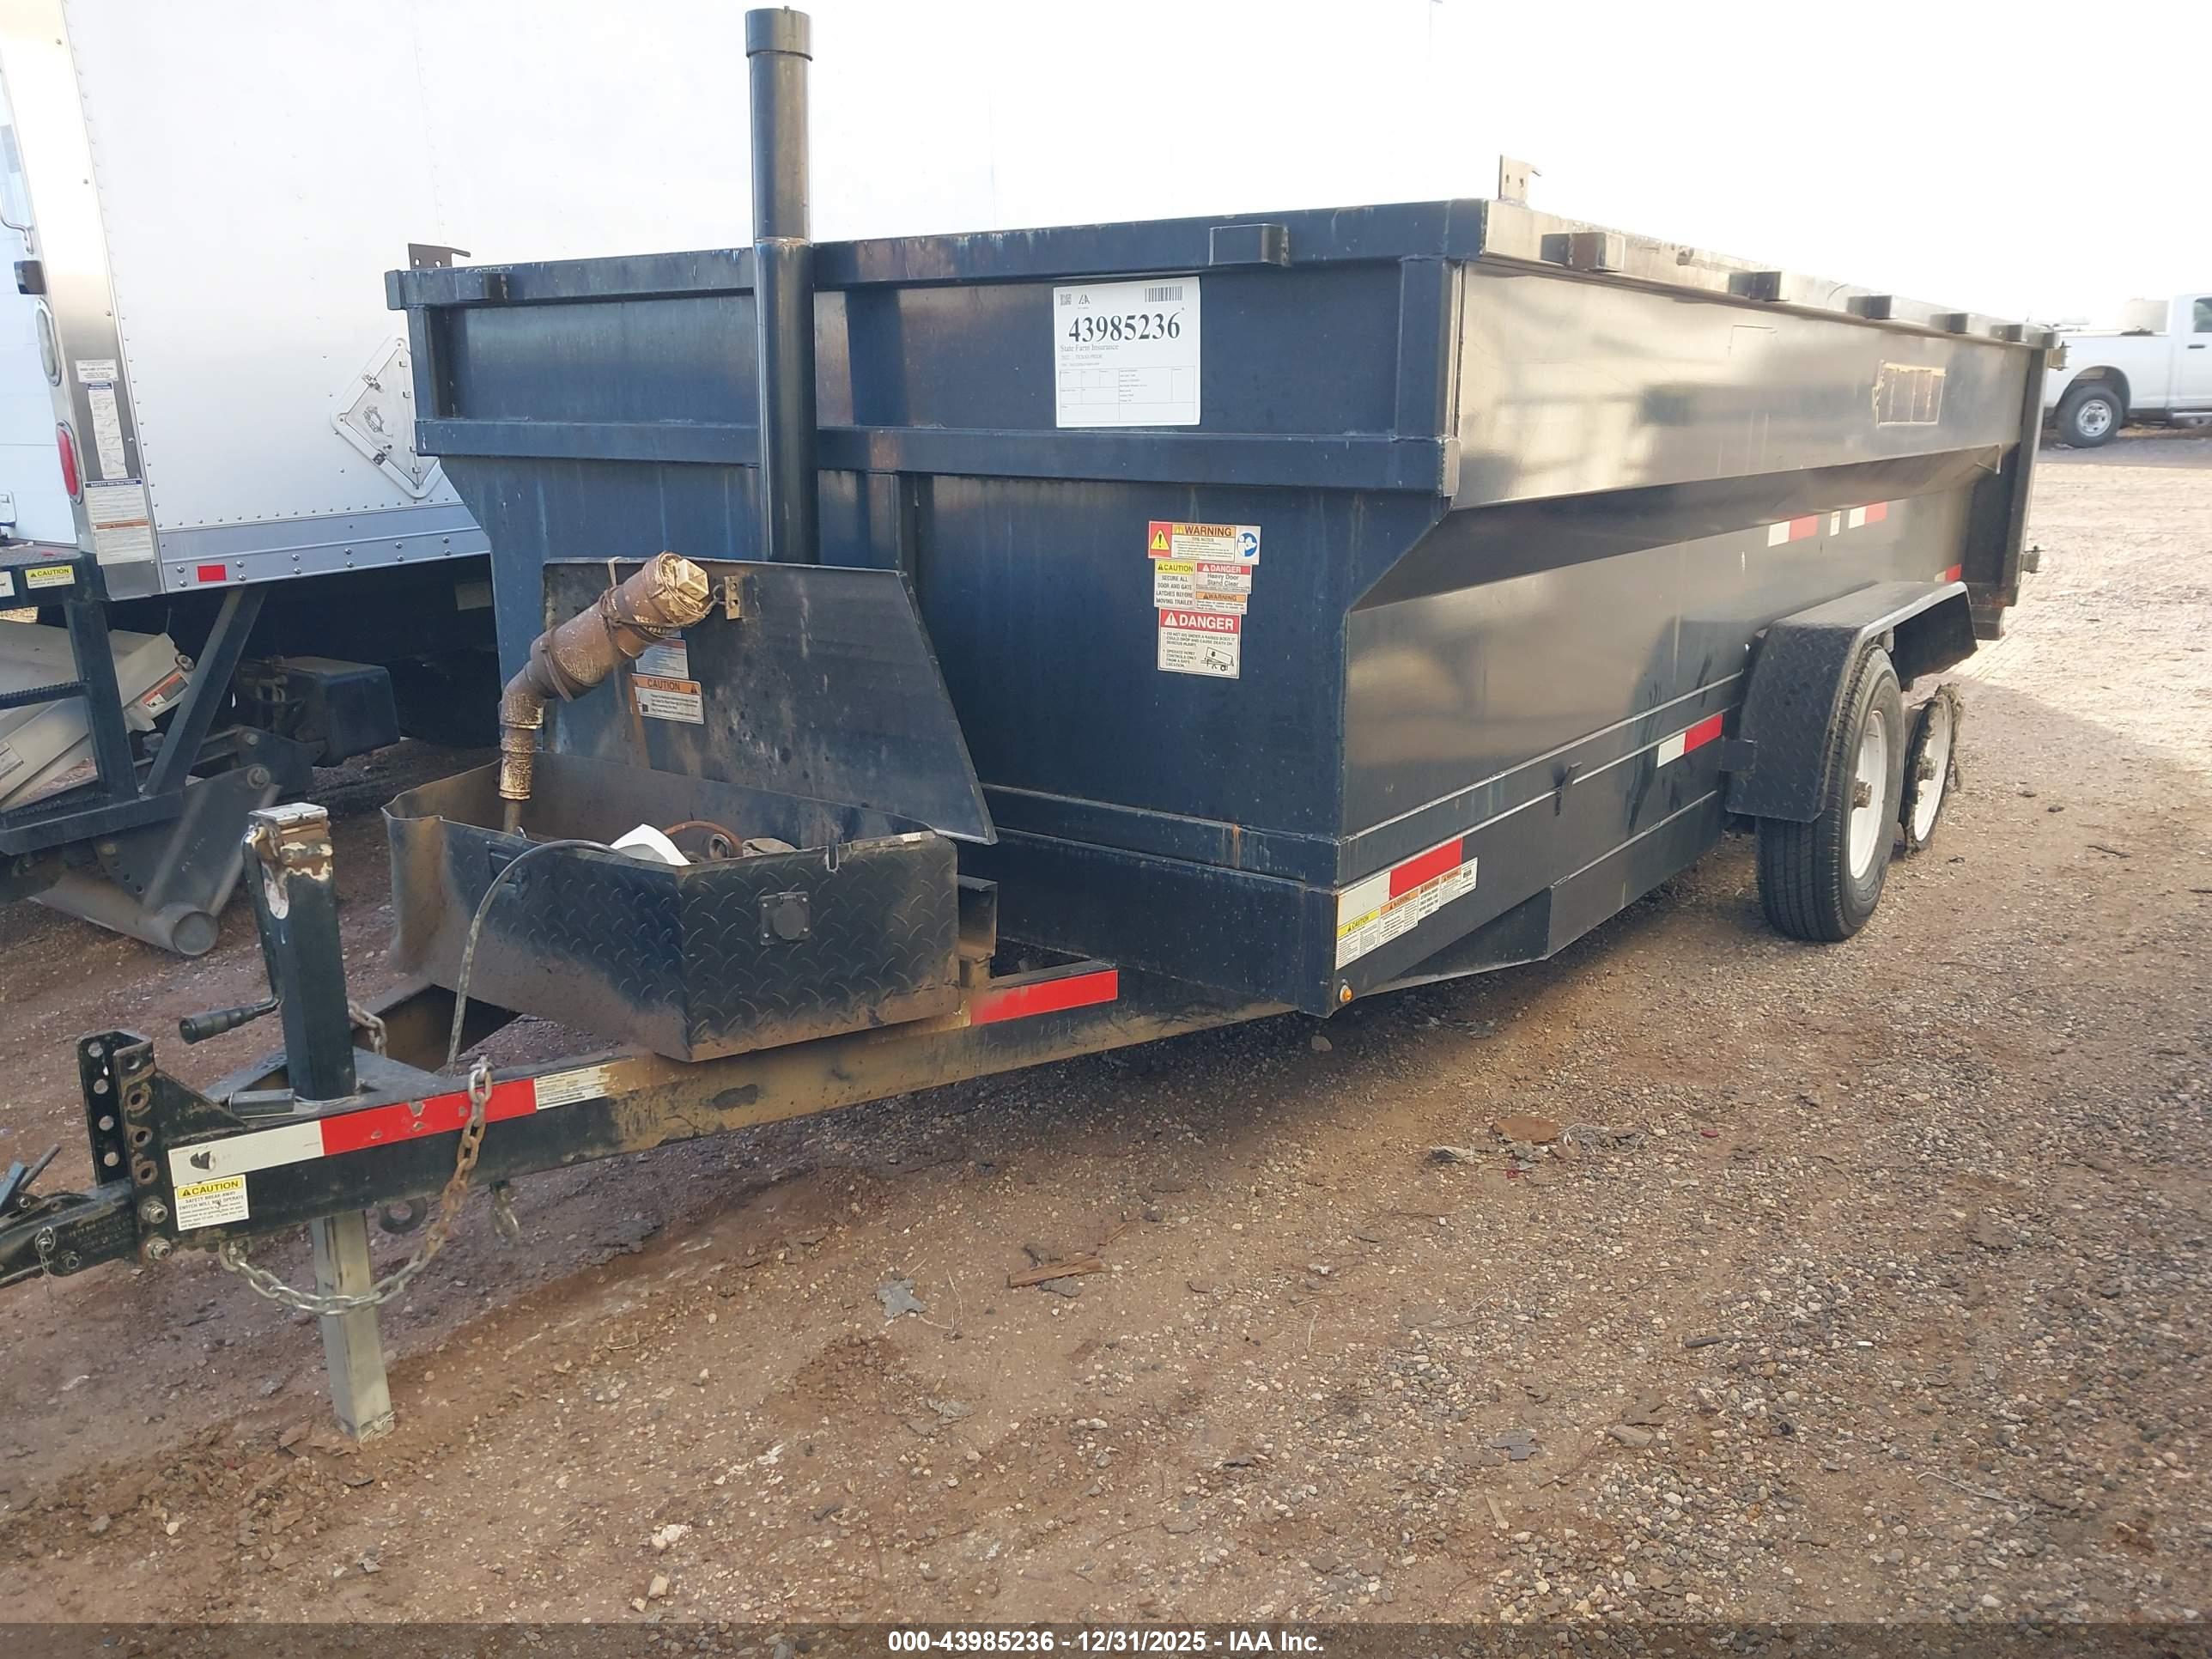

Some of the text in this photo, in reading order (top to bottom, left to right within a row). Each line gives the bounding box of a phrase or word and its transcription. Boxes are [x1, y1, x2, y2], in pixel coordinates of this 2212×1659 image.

[1068, 312, 1181, 343] 43985236
[1184, 526, 1231, 537] WARNING
[1164, 564, 1194, 573] CAUTION
[1210, 564, 1242, 574] DANGER
[1179, 614, 1234, 631] DANGER
[647, 678, 680, 691] CAUTION
[1352, 915, 1370, 928] CAUTION
[191, 1181, 239, 1195] CAUTION
